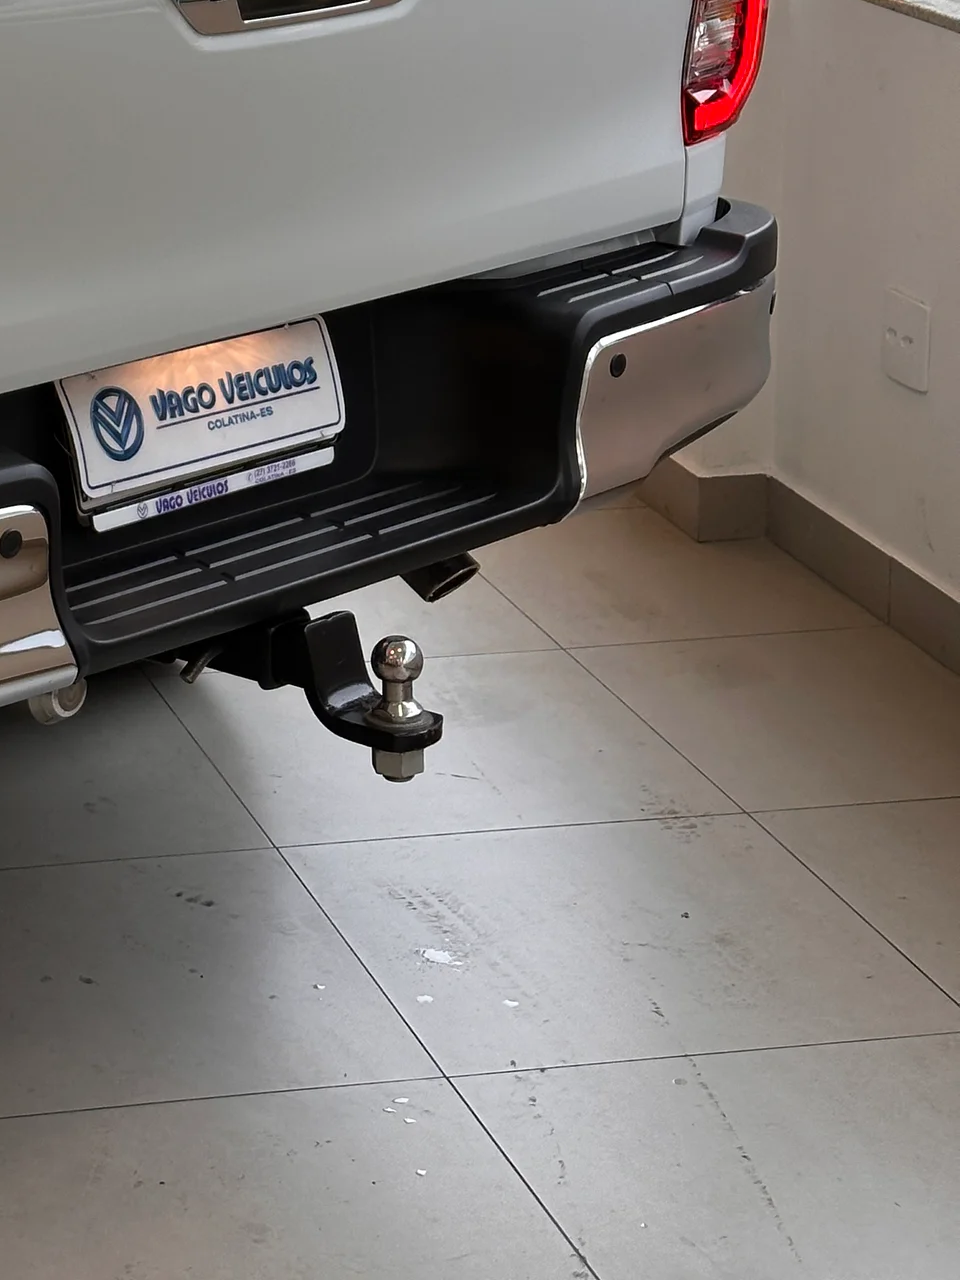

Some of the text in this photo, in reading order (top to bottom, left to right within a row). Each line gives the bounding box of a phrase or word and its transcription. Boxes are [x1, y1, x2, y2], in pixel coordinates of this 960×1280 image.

[149, 356, 318, 421] VAGO VEICULOS
[207, 406, 274, 431] COLATINA-ES
[155, 494, 184, 514] VAGO
